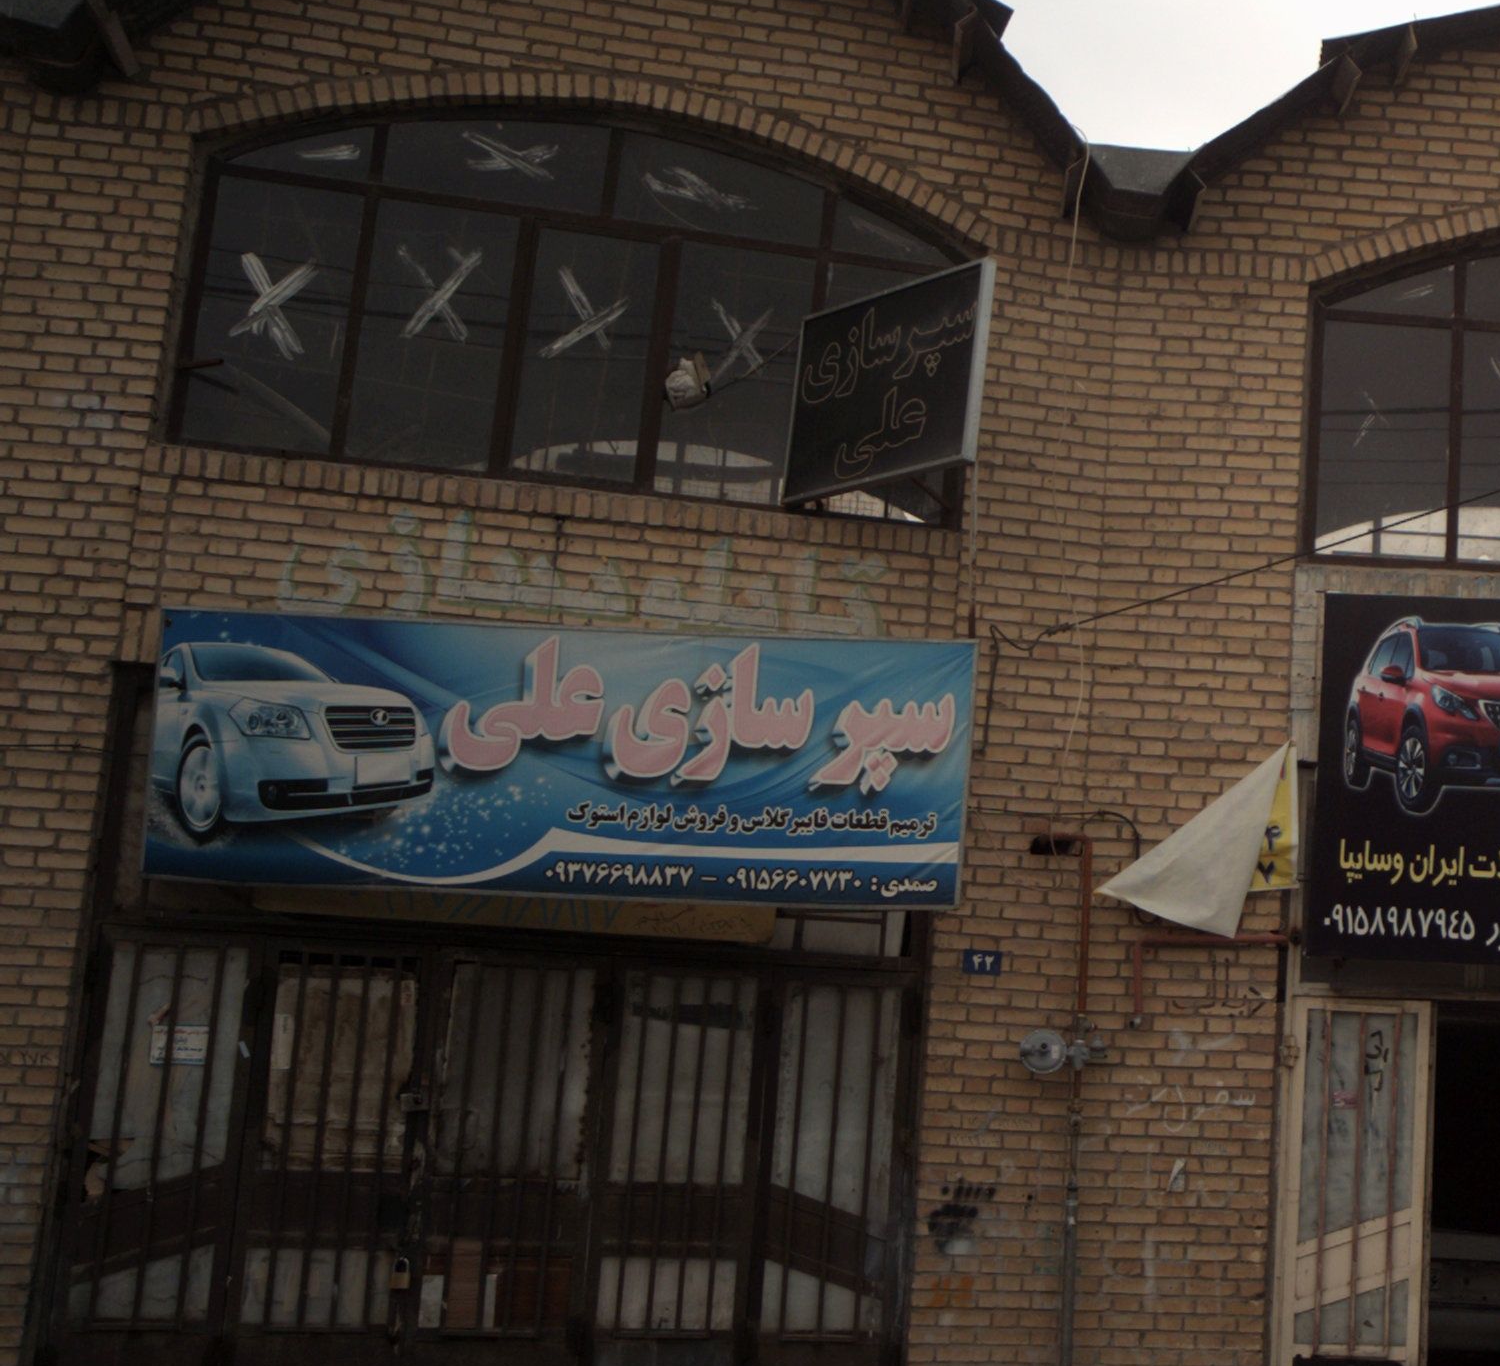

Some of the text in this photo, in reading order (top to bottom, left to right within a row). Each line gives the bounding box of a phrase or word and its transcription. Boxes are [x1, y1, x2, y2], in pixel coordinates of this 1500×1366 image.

[802, 301, 977, 403] سپر سازی
[834, 387, 926, 479] علی
[445, 635, 956, 793] سپر سازی علی
[567, 800, 627, 828] استوک
[627, 803, 673, 832] لوازم
[674, 804, 728, 833] فروش
[728, 814, 742, 834] و
[831, 808, 889, 831] قطعات
[889, 812, 938, 839] ترمیم
[1409, 844, 1466, 886] ایران
